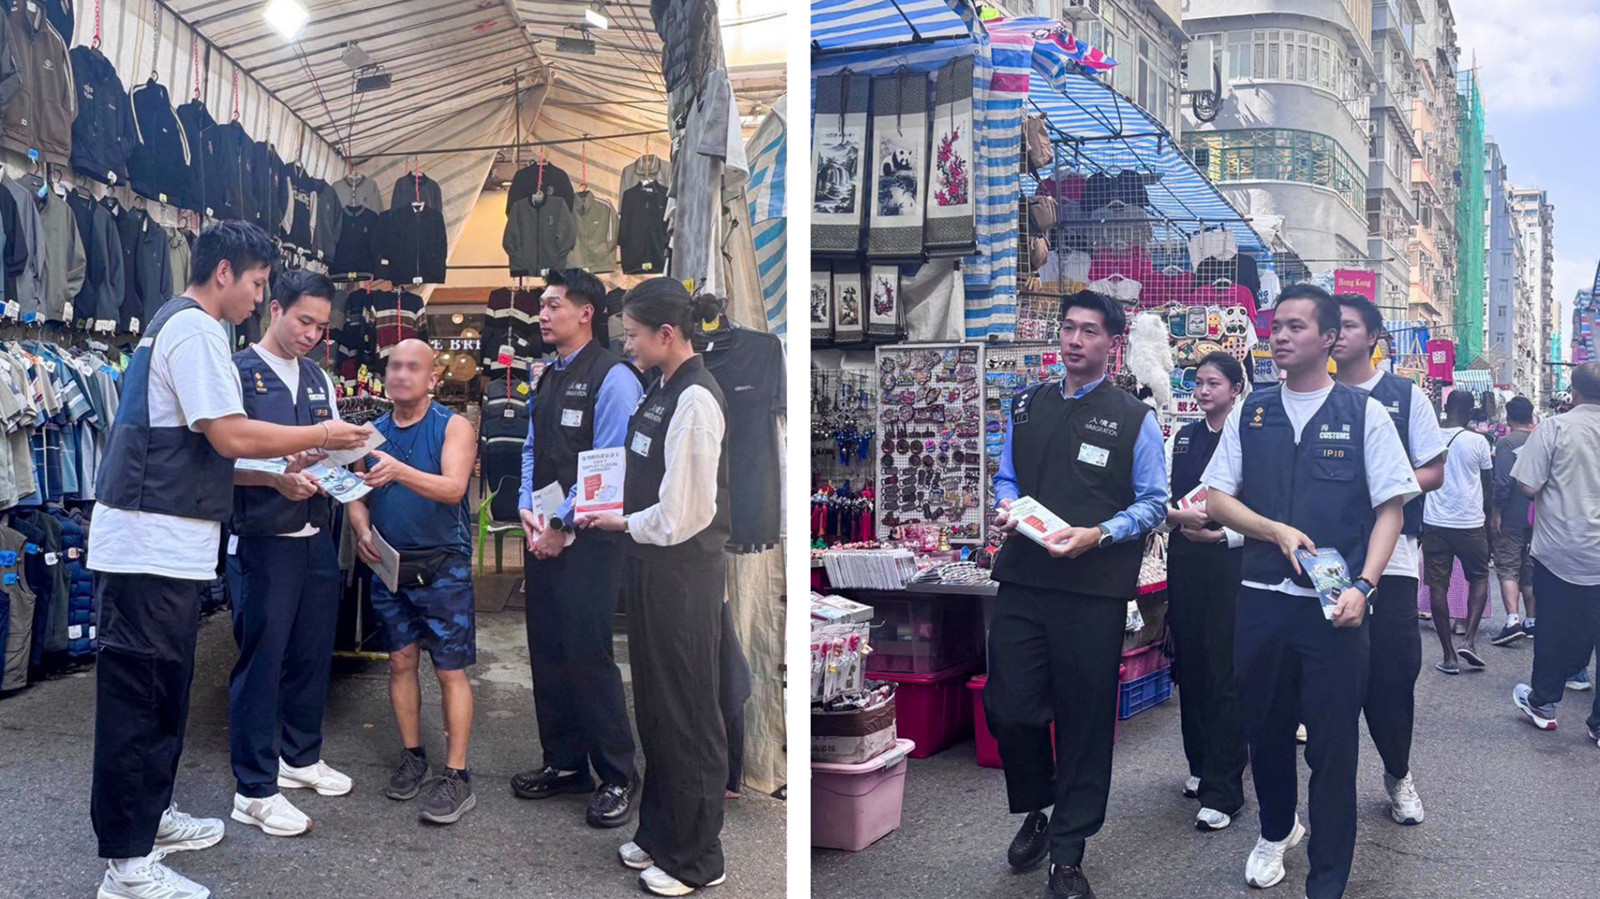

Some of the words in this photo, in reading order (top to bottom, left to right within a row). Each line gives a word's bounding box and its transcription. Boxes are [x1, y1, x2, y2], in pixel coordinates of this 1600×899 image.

[1338, 278, 1354, 287] Hong
[1355, 278, 1371, 288] Kong
[1319, 432, 1351, 440] CUSTOMS
[1323, 449, 1345, 458] IPIB
